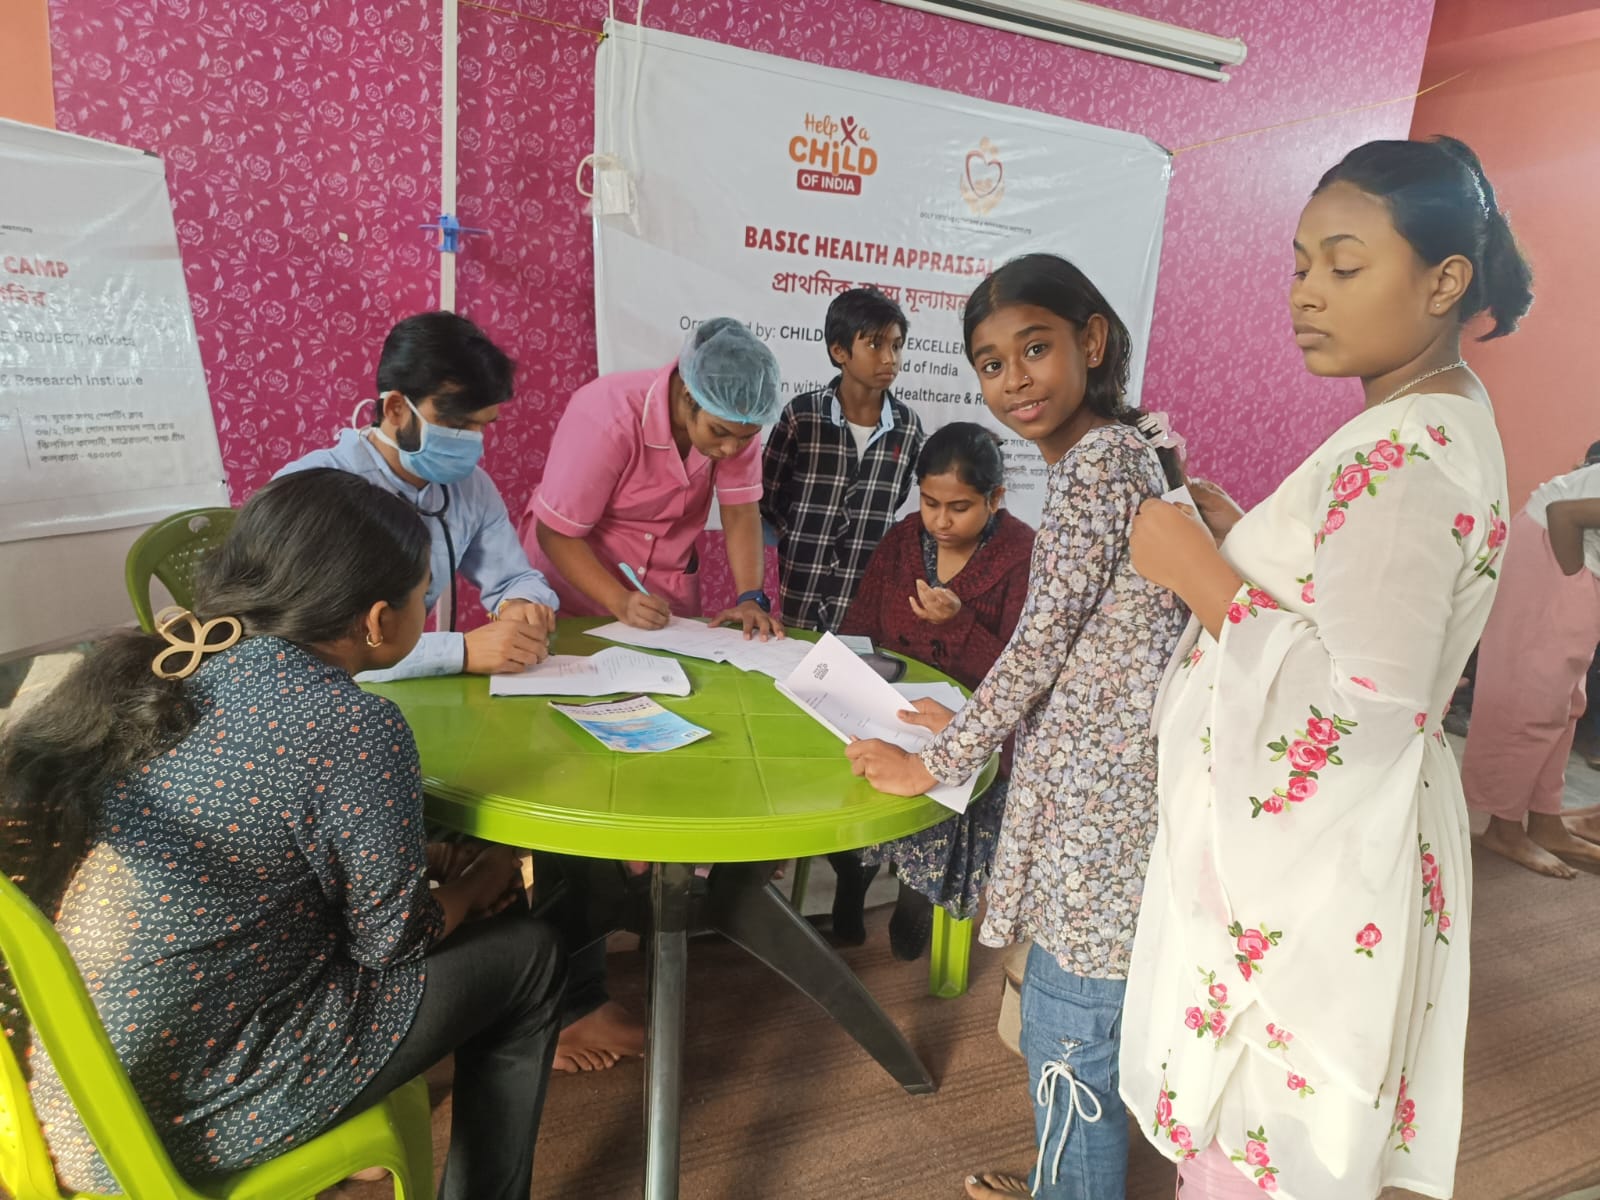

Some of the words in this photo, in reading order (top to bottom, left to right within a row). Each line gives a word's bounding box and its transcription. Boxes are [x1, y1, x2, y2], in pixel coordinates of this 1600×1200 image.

[804, 112, 838, 140] Help
[859, 127, 871, 141] a
[801, 174, 819, 188] OF
[821, 177, 855, 192] INDIA
[744, 225, 809, 256] BASIC
[815, 236, 889, 266] HEALTH
[3, 256, 70, 279] CAMP
[15, 330, 84, 347] PROJECT,
[756, 322, 776, 341] by:
[780, 325, 824, 342] CHILD
[907, 337, 965, 355] EXCELLEN
[913, 360, 928, 374] of
[929, 362, 959, 377] India
[15, 374, 83, 387] Research
[86, 375, 144, 386] Institute
[894, 386, 961, 404] Healthcare
[964, 392, 972, 404] &
